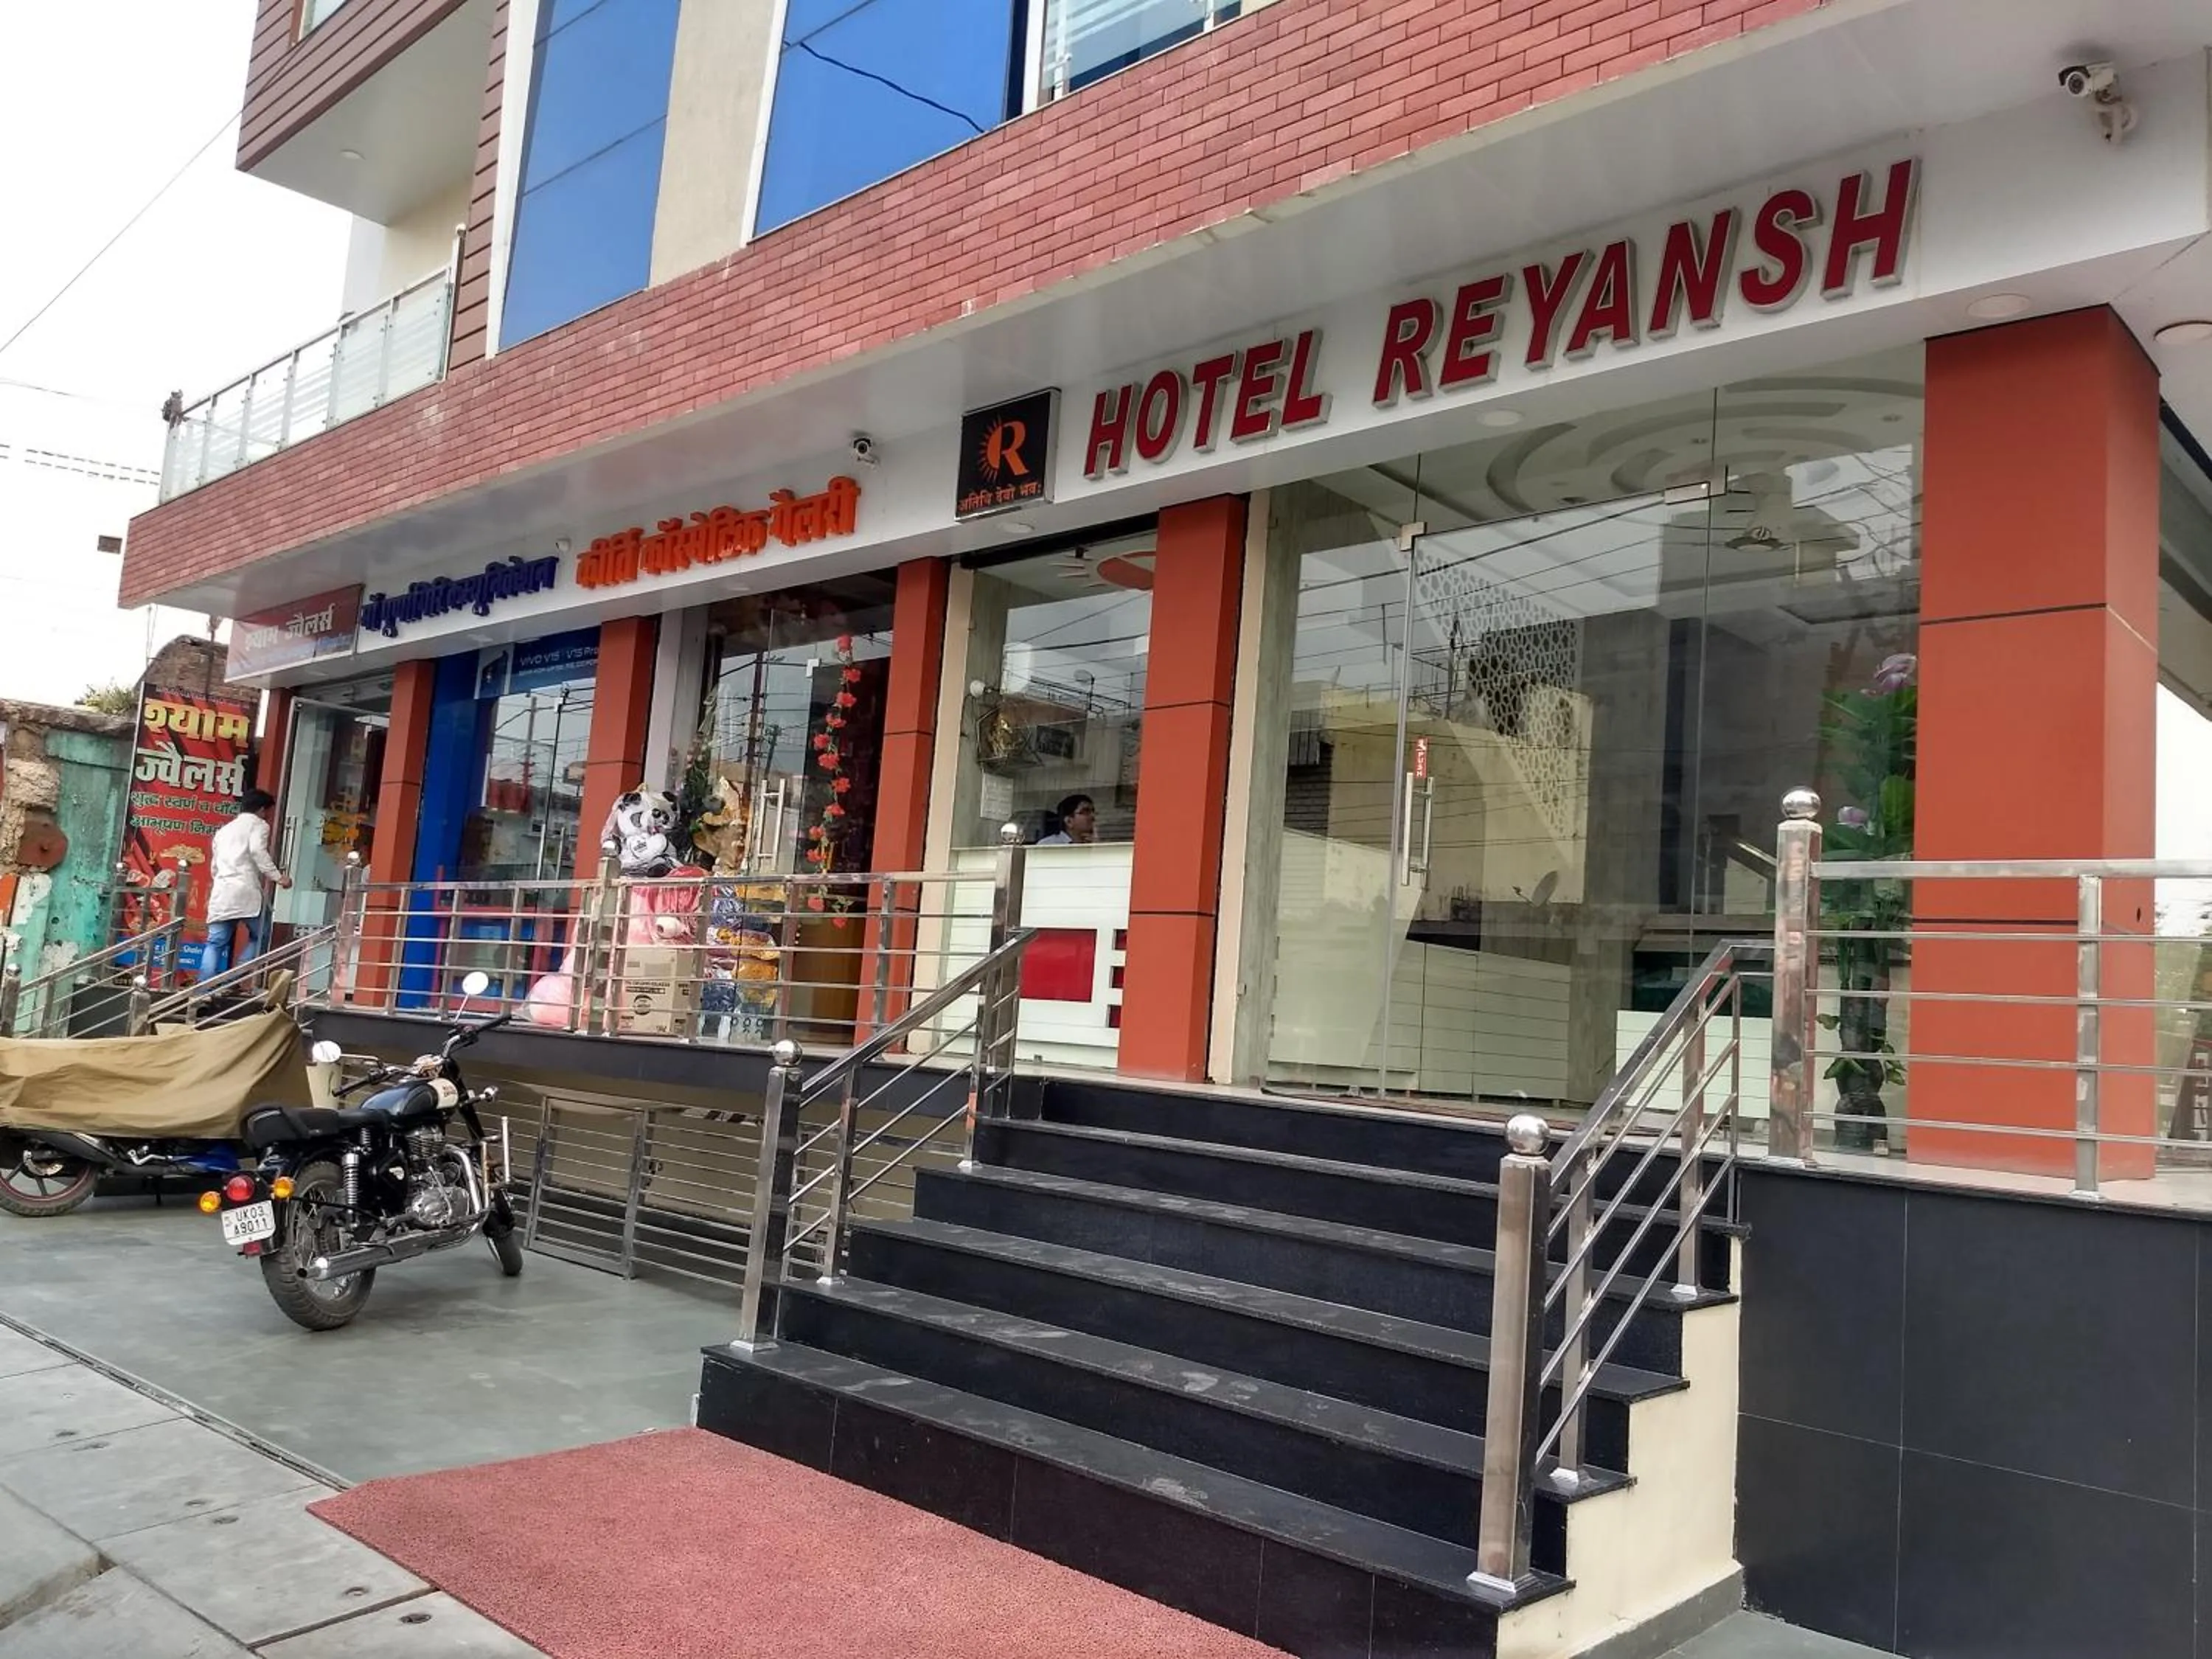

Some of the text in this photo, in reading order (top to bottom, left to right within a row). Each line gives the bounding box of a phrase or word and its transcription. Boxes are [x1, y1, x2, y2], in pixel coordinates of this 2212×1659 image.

[1084, 157, 1920, 480] HOTEL REYANSH
[145, 697, 250, 748] श्याम
[236, 1206, 265, 1222] UK03
